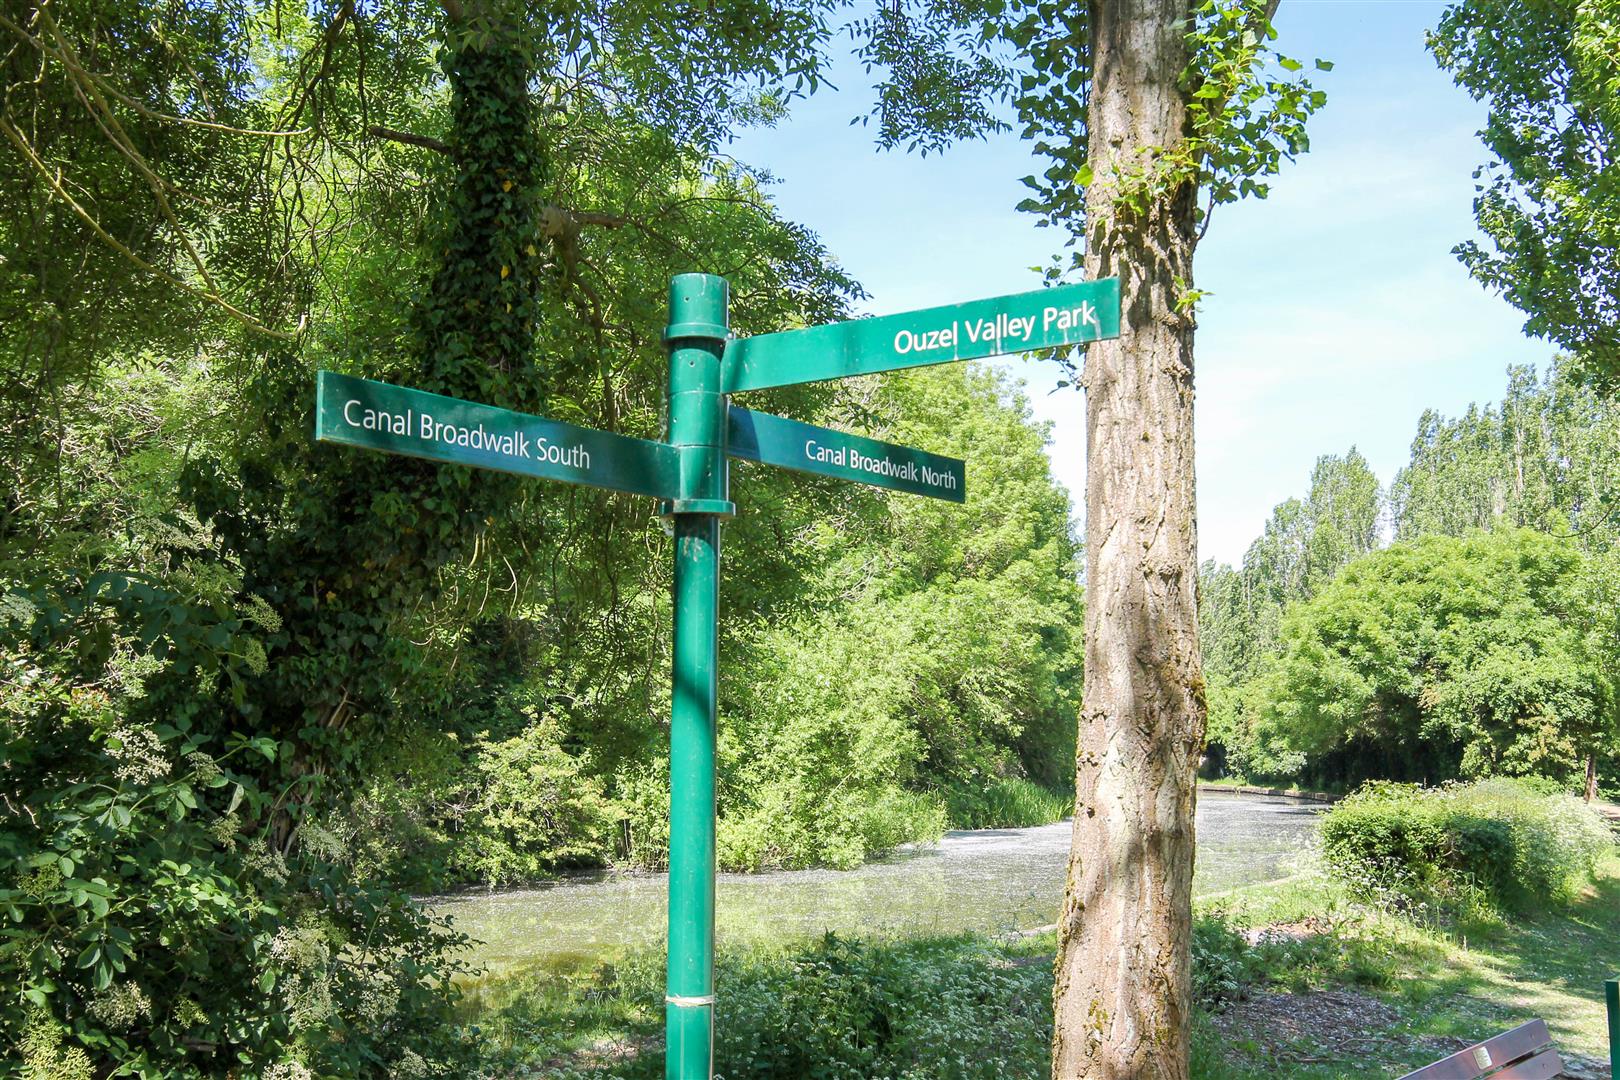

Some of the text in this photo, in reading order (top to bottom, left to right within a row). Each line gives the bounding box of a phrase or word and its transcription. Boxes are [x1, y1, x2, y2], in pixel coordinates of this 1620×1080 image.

[893, 300, 1096, 354] Ouzel Valley Park
[343, 399, 590, 469] Canal Broadwalk South
[805, 440, 956, 490] Canal Broadwalk North
